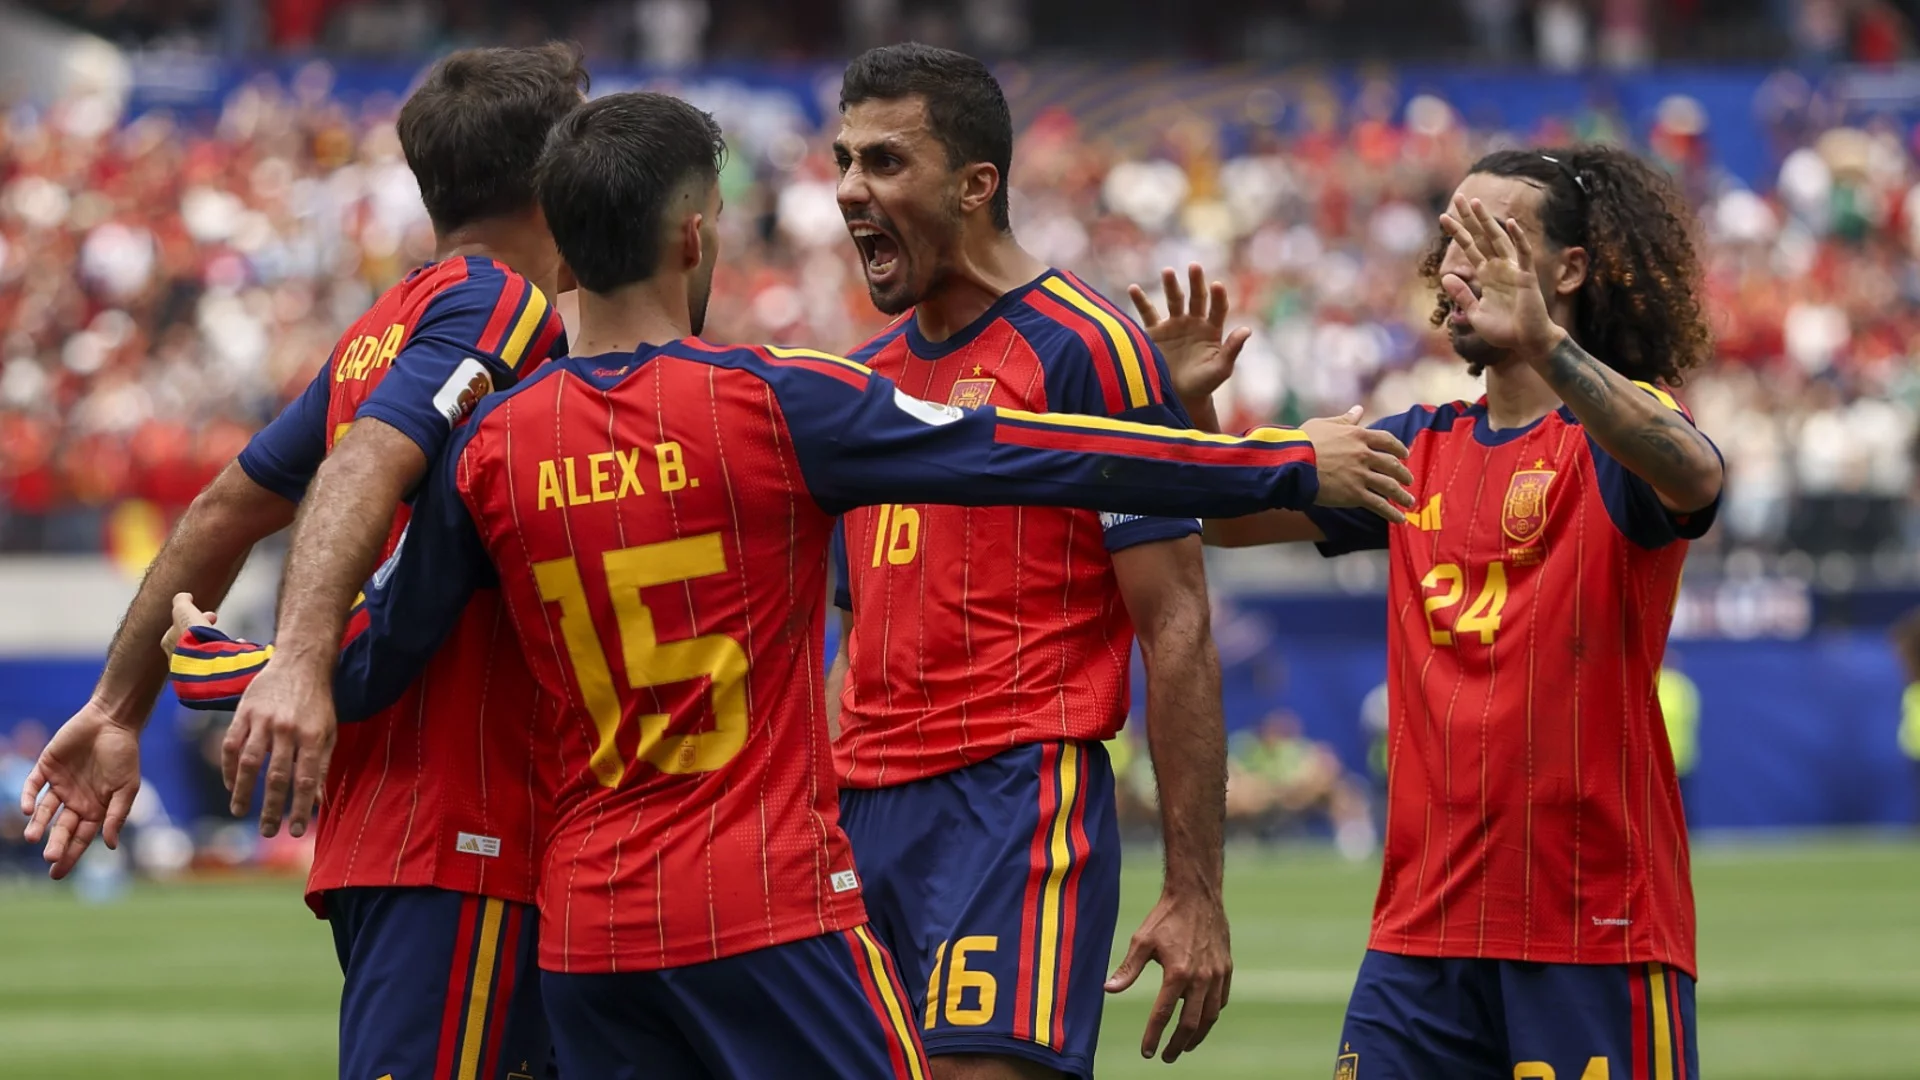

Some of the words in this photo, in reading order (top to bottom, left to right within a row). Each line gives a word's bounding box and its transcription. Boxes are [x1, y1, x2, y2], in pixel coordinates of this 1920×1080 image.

[537, 447, 645, 512] ALEX
[654, 441, 700, 492] B.
[871, 503, 921, 569] 16
[1420, 561, 1508, 645] 24
[531, 531, 749, 790] 15
[923, 935, 998, 1031] 16
